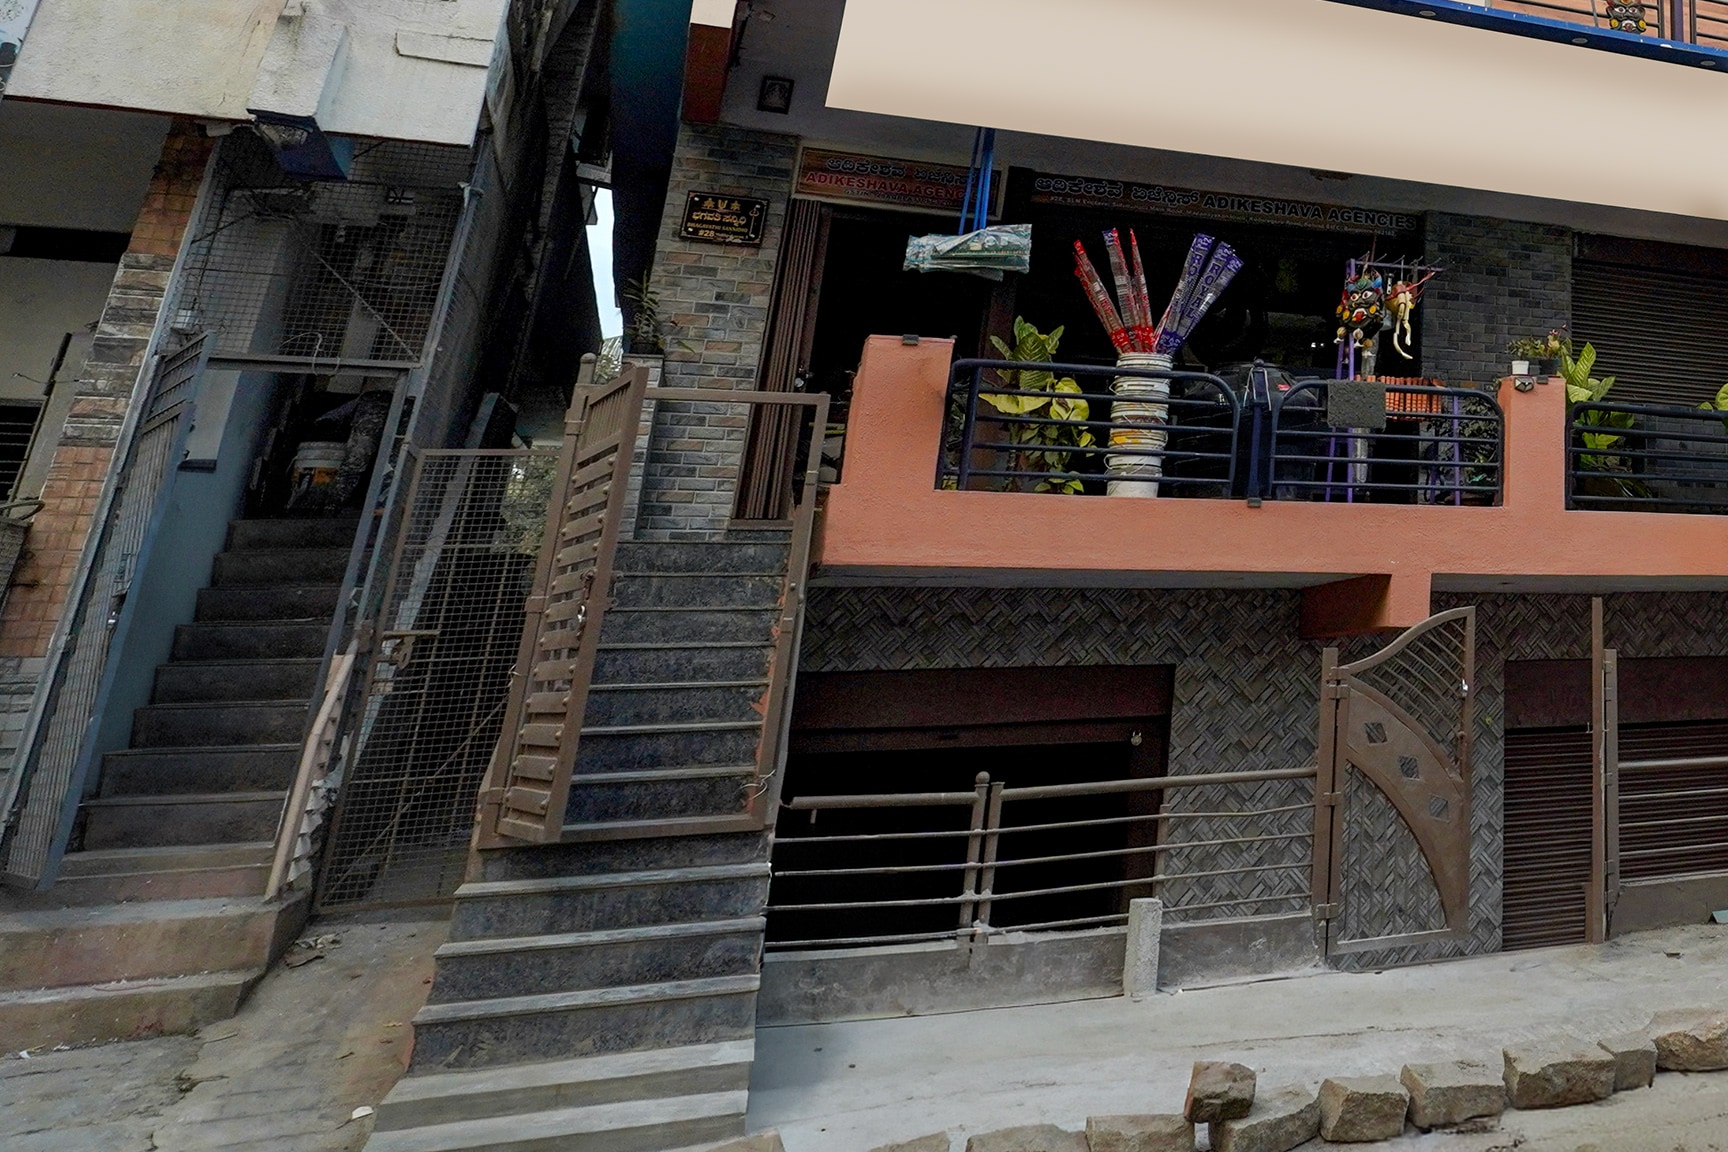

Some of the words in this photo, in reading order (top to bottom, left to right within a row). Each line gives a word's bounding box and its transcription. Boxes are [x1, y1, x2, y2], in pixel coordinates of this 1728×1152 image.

[1203, 194, 1323, 219] ADIKESHAVA
[1327, 209, 1417, 230] AGENCIES
[1186, 262, 1222, 319] ROYAL
